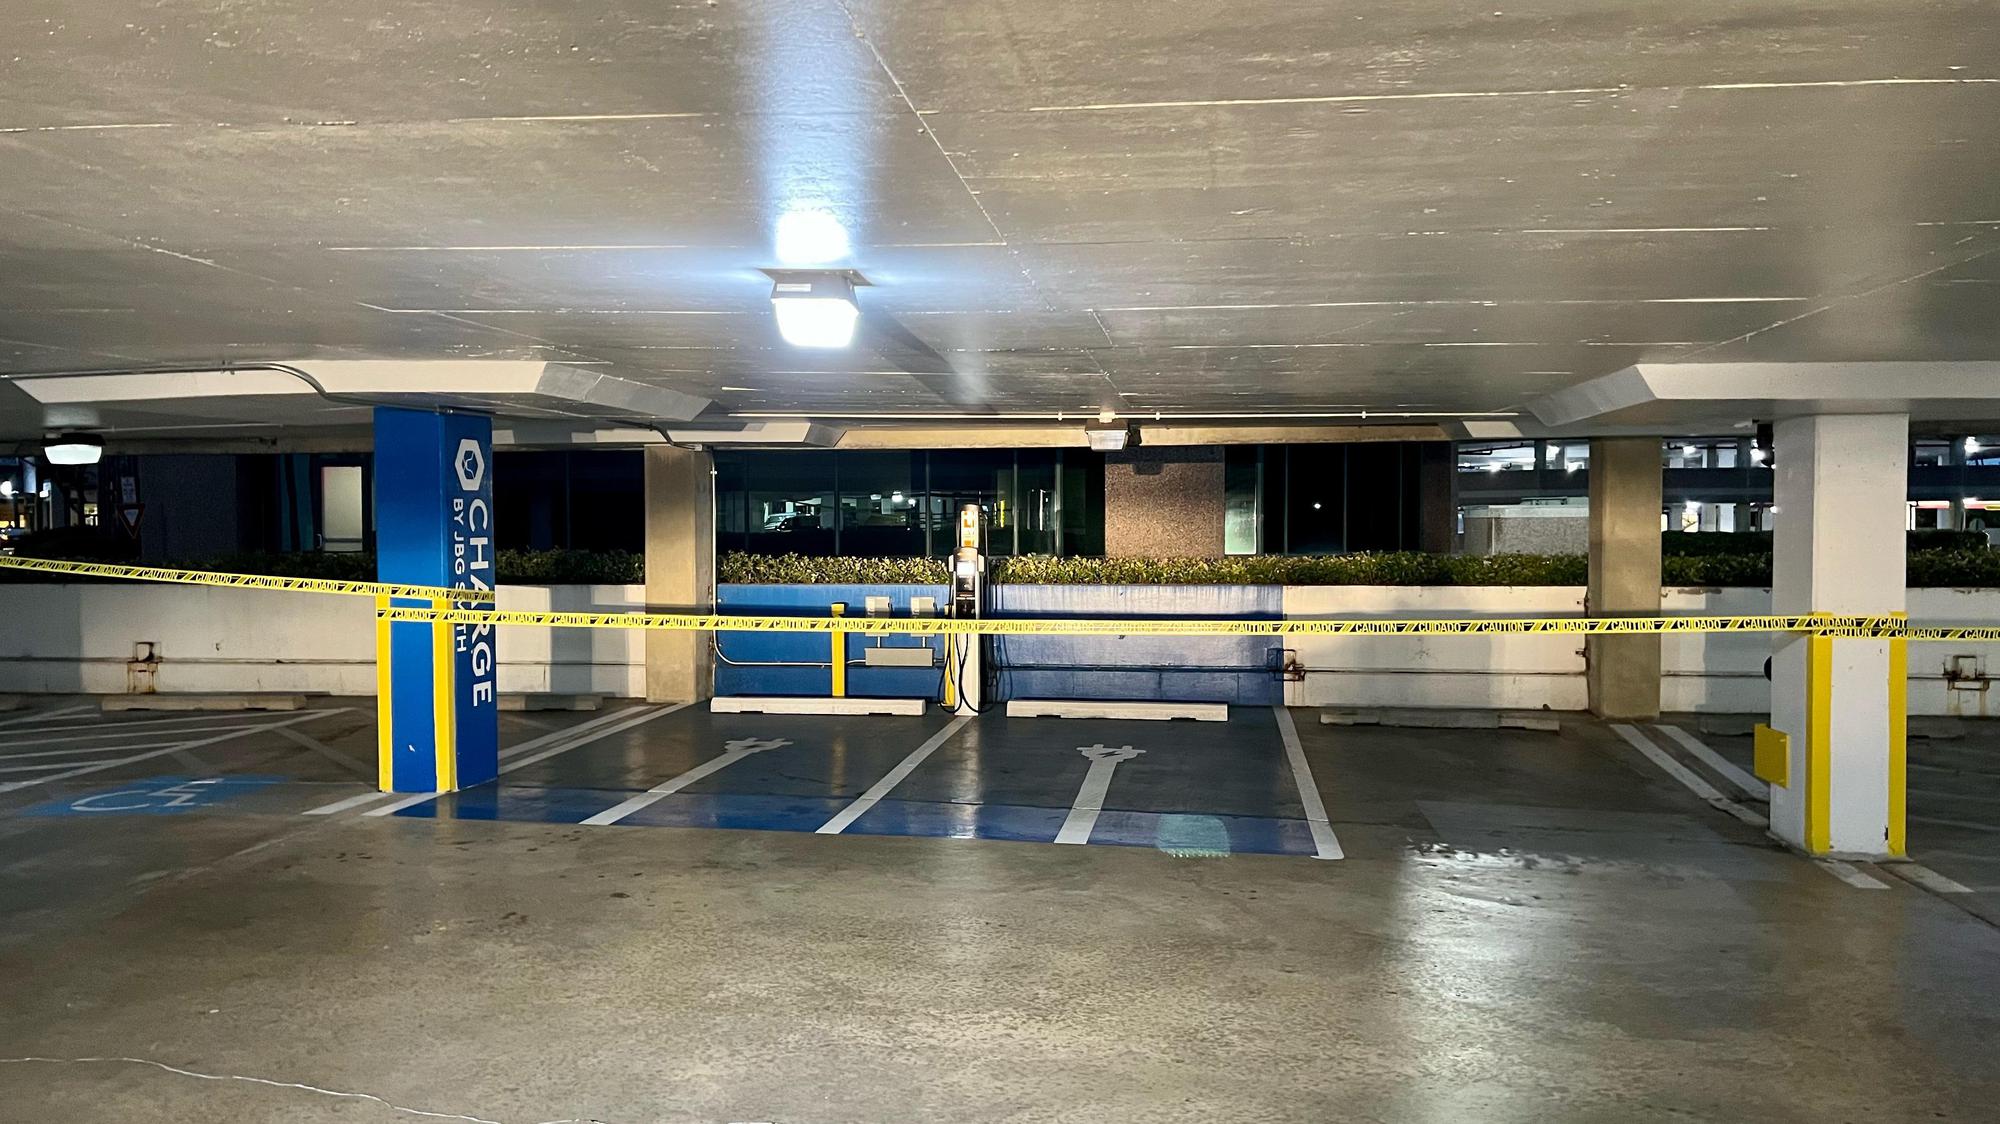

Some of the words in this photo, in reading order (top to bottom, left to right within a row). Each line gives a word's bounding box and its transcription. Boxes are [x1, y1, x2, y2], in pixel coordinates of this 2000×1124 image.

[453, 499, 464, 525] BY
[454, 531, 466, 574] JBG
[142, 569, 178, 580] CAUTION
[195, 573, 232, 583] CUIDADO
[248, 577, 285, 588] CAUTION
[302, 581, 339, 590] CUIDADO
[355, 584, 391, 595] CAUTION
[410, 588, 447, 598] CUIDADO
[469, 498, 492, 707] CHARGE
[395, 610, 431, 619] CUIDADO
[447, 611, 483, 621] CAUTION
[500, 613, 537, 623] CUIDADO
[553, 615, 590, 625] CAUTION
[608, 616, 645, 625] CUIDADO
[663, 617, 699, 628] CAUTION
[718, 619, 755, 628] CUIDADO
[772, 620, 810, 630] CAUTION
[829, 620, 866, 630] CUIDADO
[885, 621, 922, 631] CAUTION
[942, 621, 979, 631] CUIDADO
[999, 622, 1036, 632] CAUTION
[1233, 623, 1273, 633] CAUTION
[1294, 623, 1334, 633] CUIDADO
[1356, 623, 1397, 633] CAUTION
[1418, 622, 1461, 633] CUIDADO
[1482, 622, 1524, 632] CAUTION
[1546, 621, 1590, 632] CUIDADO
[1610, 620, 1654, 631] CAUTION
[1677, 619, 1721, 630] CUIDADO
[1743, 618, 1788, 629] CAUTION
[1811, 618, 1856, 628] CUIDADO
[1895, 628, 1942, 638] CUIDADO
